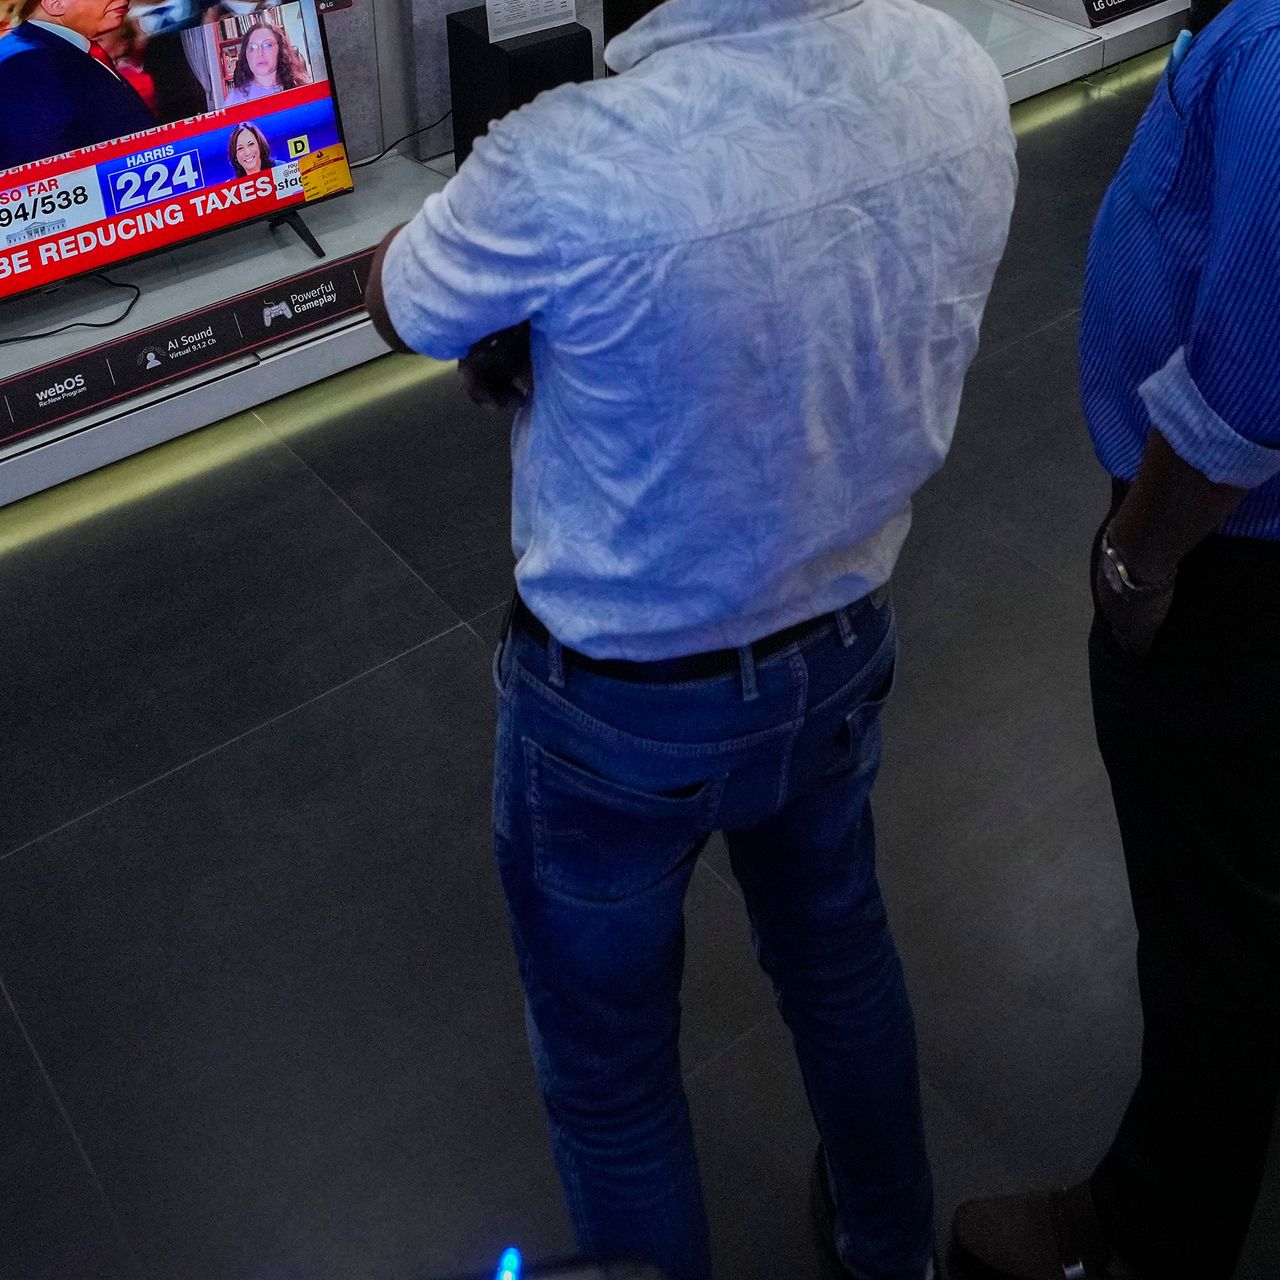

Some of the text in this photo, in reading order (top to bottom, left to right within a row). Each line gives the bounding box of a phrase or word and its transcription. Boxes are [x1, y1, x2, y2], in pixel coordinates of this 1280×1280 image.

[126, 144, 175, 167] HARRIS
[293, 140, 305, 154] D
[0, 178, 59, 205] SO FAR
[114, 154, 200, 211] 224
[39, 204, 184, 265] REDUCING
[190, 176, 274, 218] TAXES
[290, 281, 335, 304] Powerful
[294, 291, 337, 316] Gameplay
[167, 326, 214, 352] AI Sound
[35, 374, 85, 401] webOS
[38, 385, 87, 408] Re:New Program
